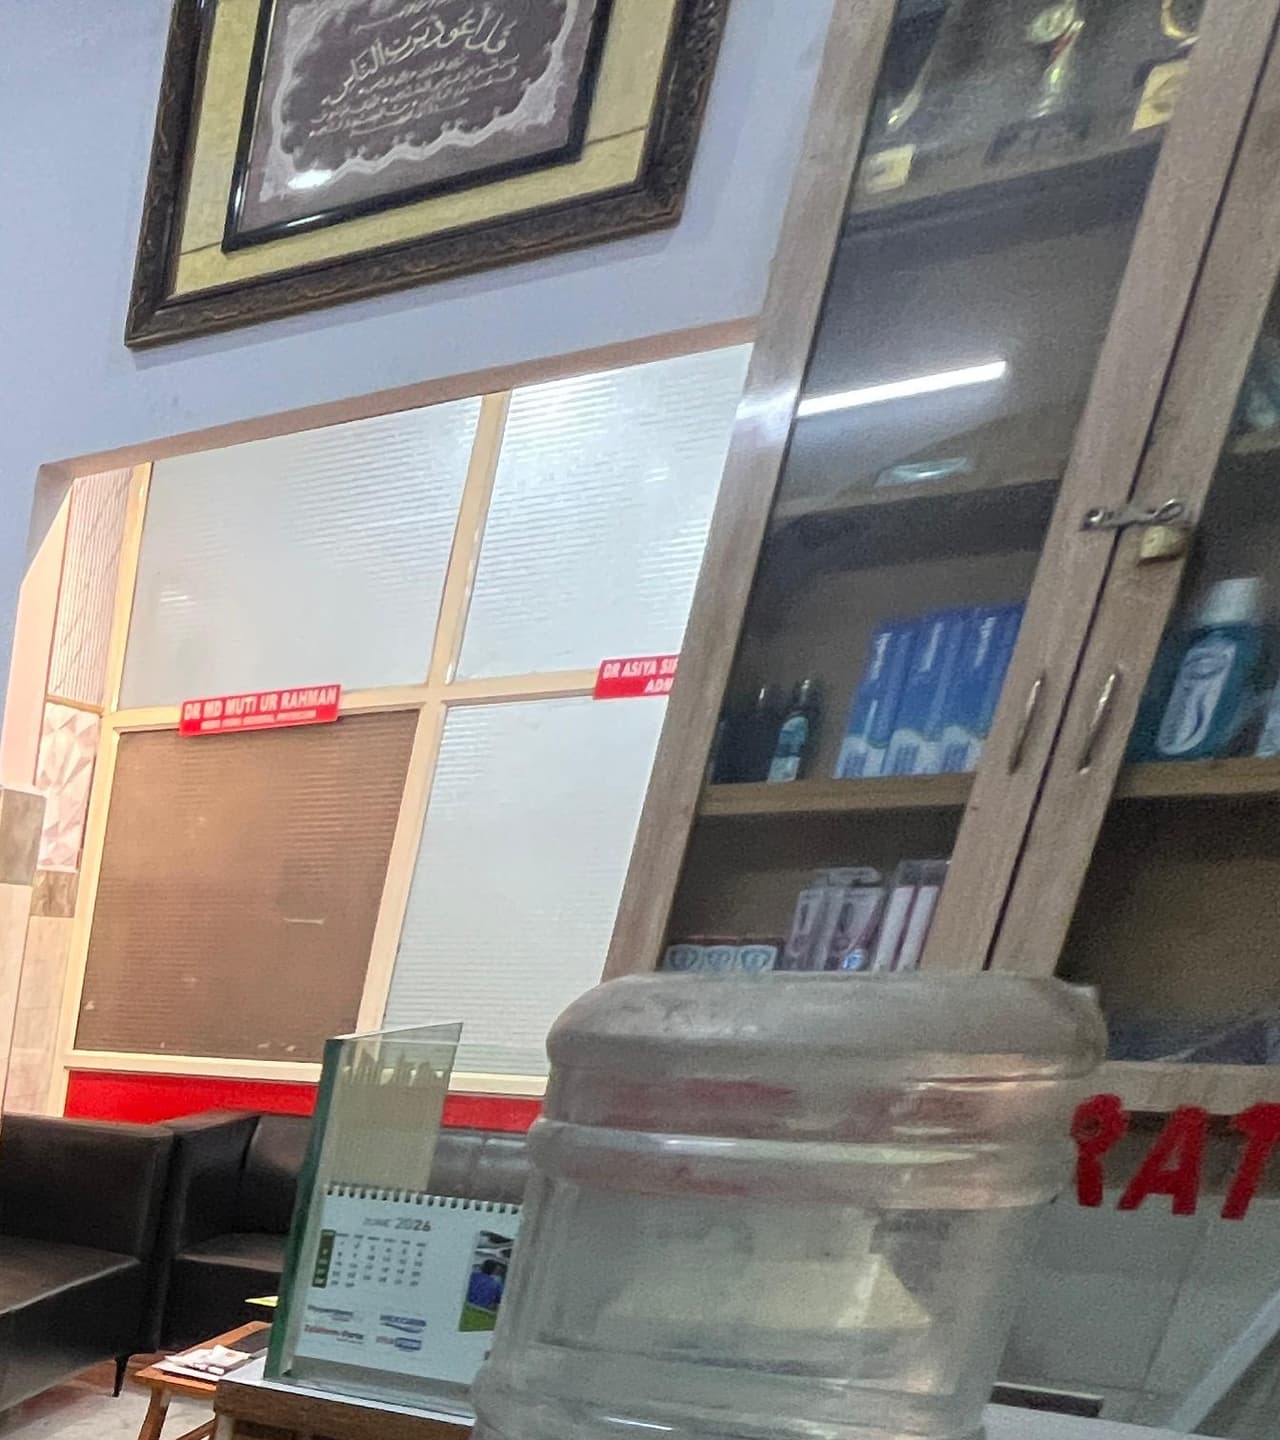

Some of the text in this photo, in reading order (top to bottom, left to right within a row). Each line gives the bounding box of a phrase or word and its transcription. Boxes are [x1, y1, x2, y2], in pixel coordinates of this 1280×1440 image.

[621, 660, 657, 677] ASIYA
[259, 693, 278, 712] UR
[281, 687, 337, 709] RAHMAN
